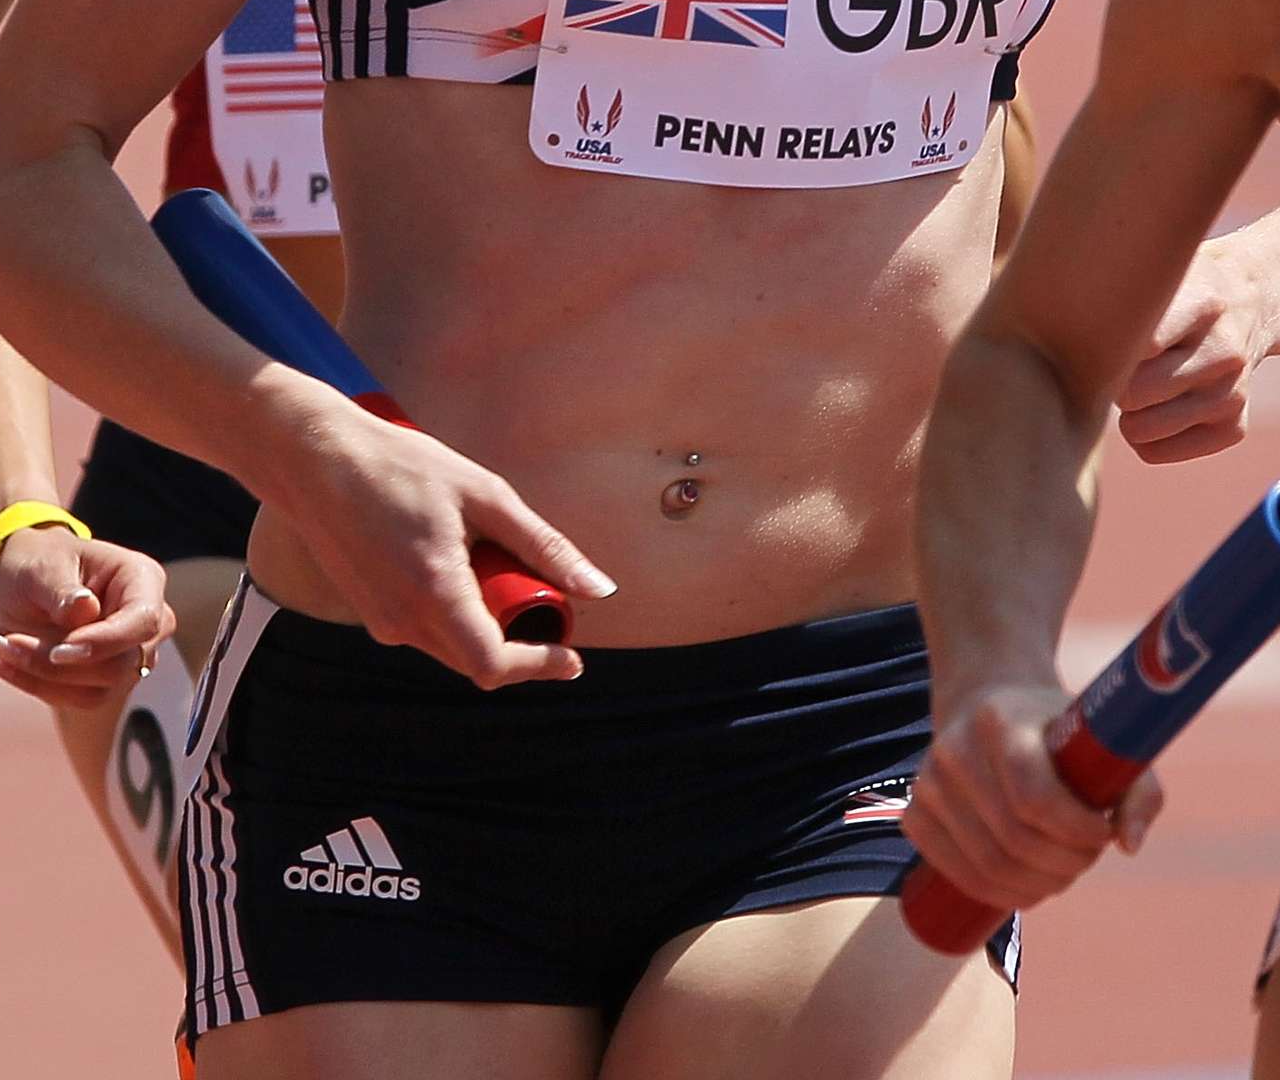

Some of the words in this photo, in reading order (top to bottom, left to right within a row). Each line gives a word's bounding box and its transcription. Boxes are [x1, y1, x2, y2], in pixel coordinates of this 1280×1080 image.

[575, 138, 612, 155] USA
[654, 113, 765, 159] PENN
[776, 119, 897, 160] RELAYS
[919, 141, 947, 159] USA
[117, 706, 176, 870] 9
[282, 861, 422, 902] adidas
